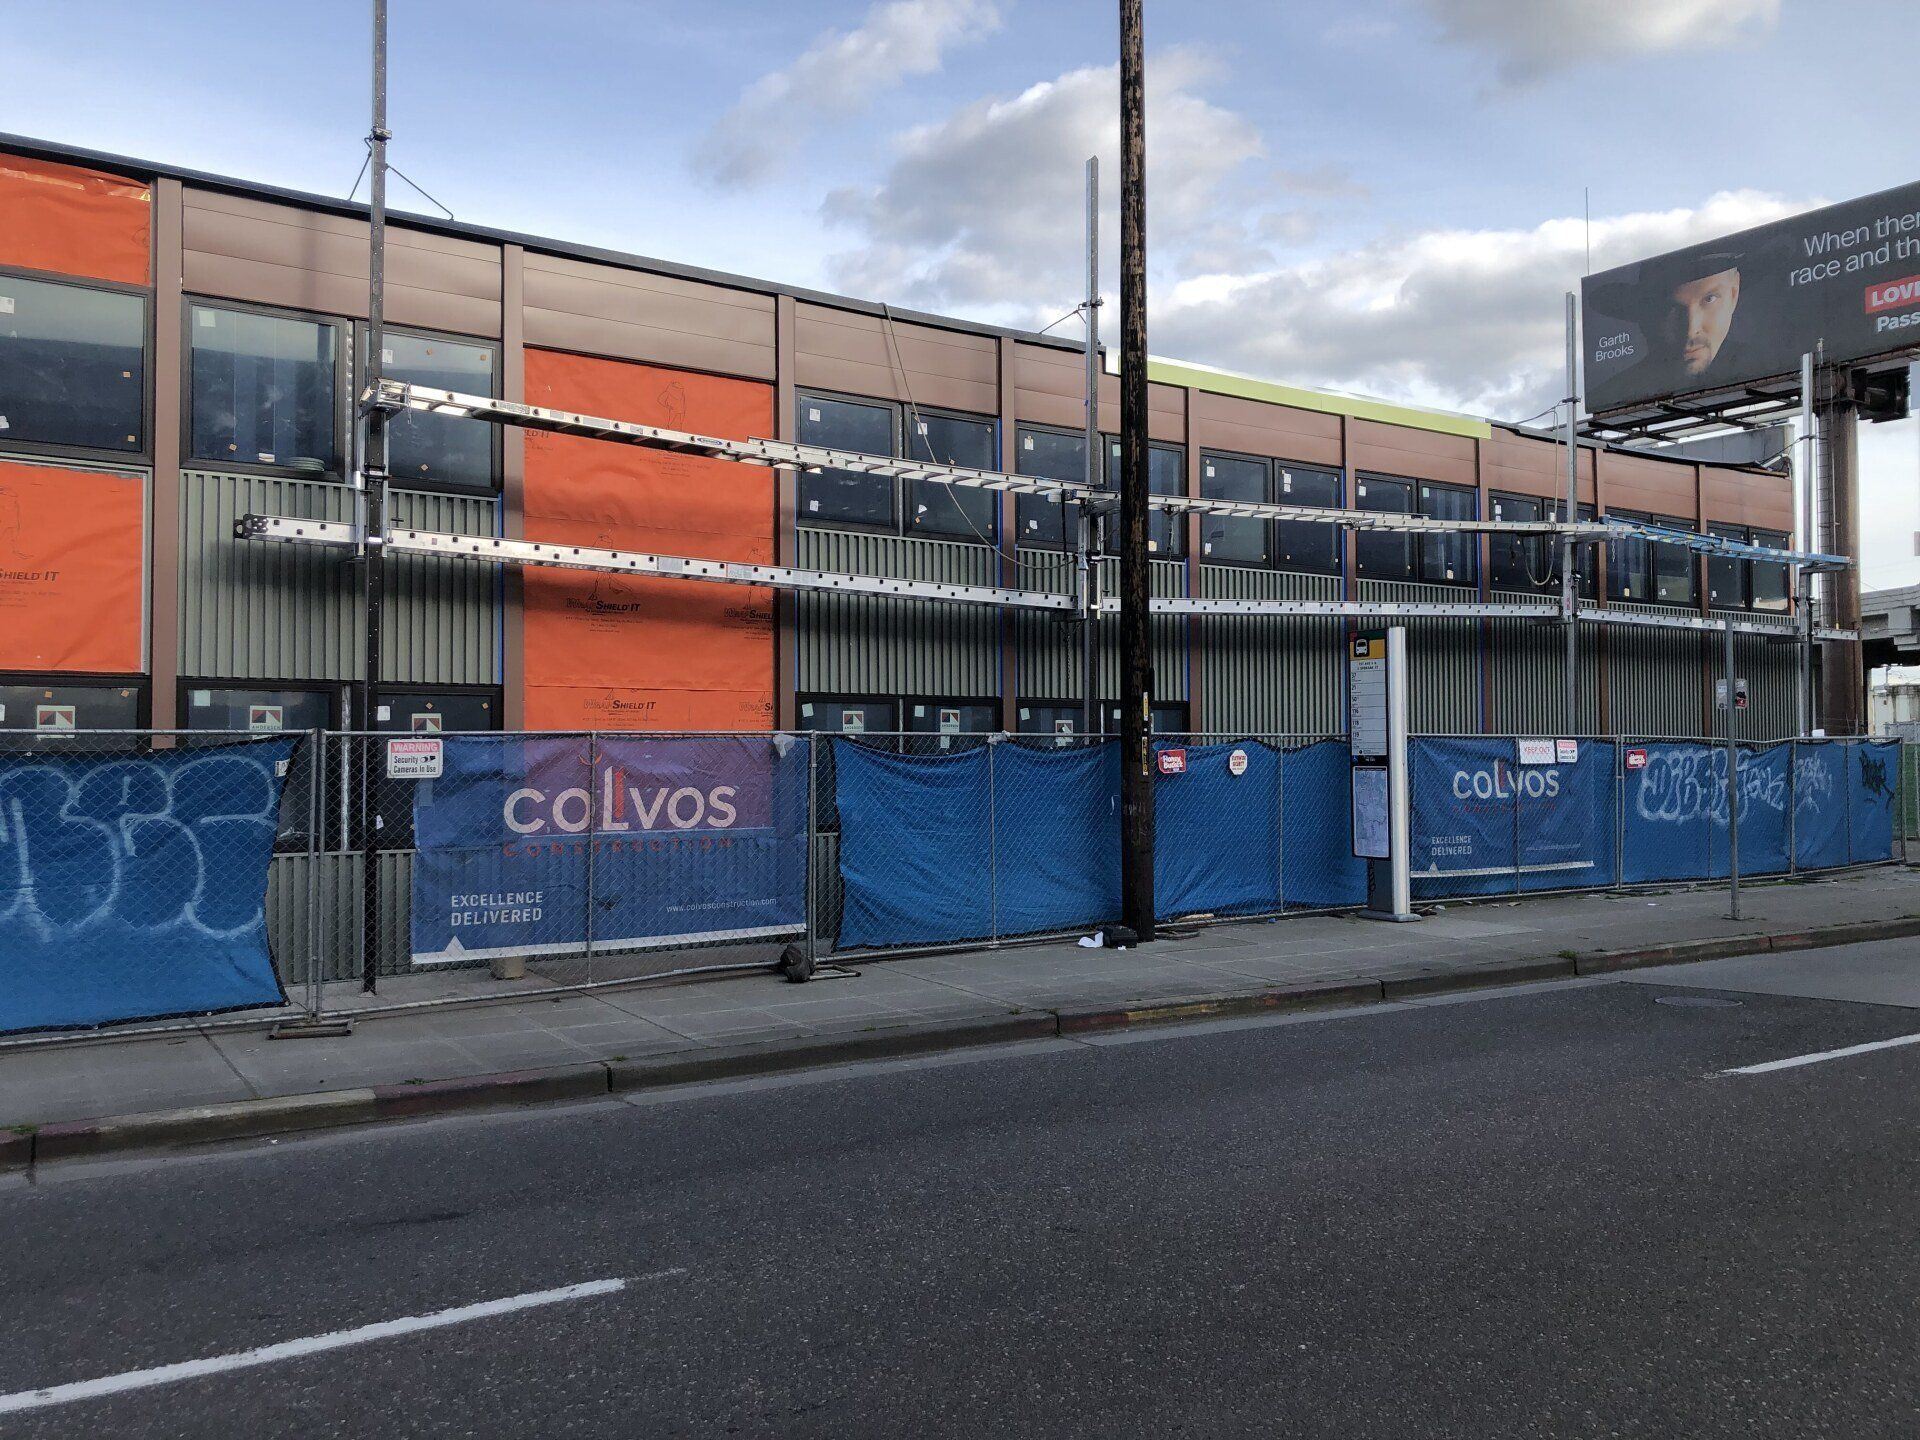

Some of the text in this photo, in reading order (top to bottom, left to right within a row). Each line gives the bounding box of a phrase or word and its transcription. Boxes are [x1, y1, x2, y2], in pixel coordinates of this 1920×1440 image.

[1804, 226, 1870, 257] When
[1790, 259, 1841, 287] race
[1845, 241, 1890, 273] and
[1877, 311, 1920, 332] Pass
[1599, 332, 1630, 348] Garth
[1596, 345, 1634, 362] Brooks
[44, 571, 60, 581] IT
[646, 702, 656, 710] IT
[394, 742, 439, 752] WARNING
[394, 755, 419, 764] Security
[393, 765, 418, 774] Cameras
[426, 764, 437, 773] Use
[1453, 759, 1560, 800] COLVOS
[503, 765, 737, 834] COLVOS
[502, 835, 732, 857] CONSTRUCTION
[1431, 835, 1472, 845] EXCELLENCE
[1431, 846, 1473, 856] DELIVERED
[451, 891, 544, 908] EXCELLENCE
[451, 907, 543, 926] DELIVERED
